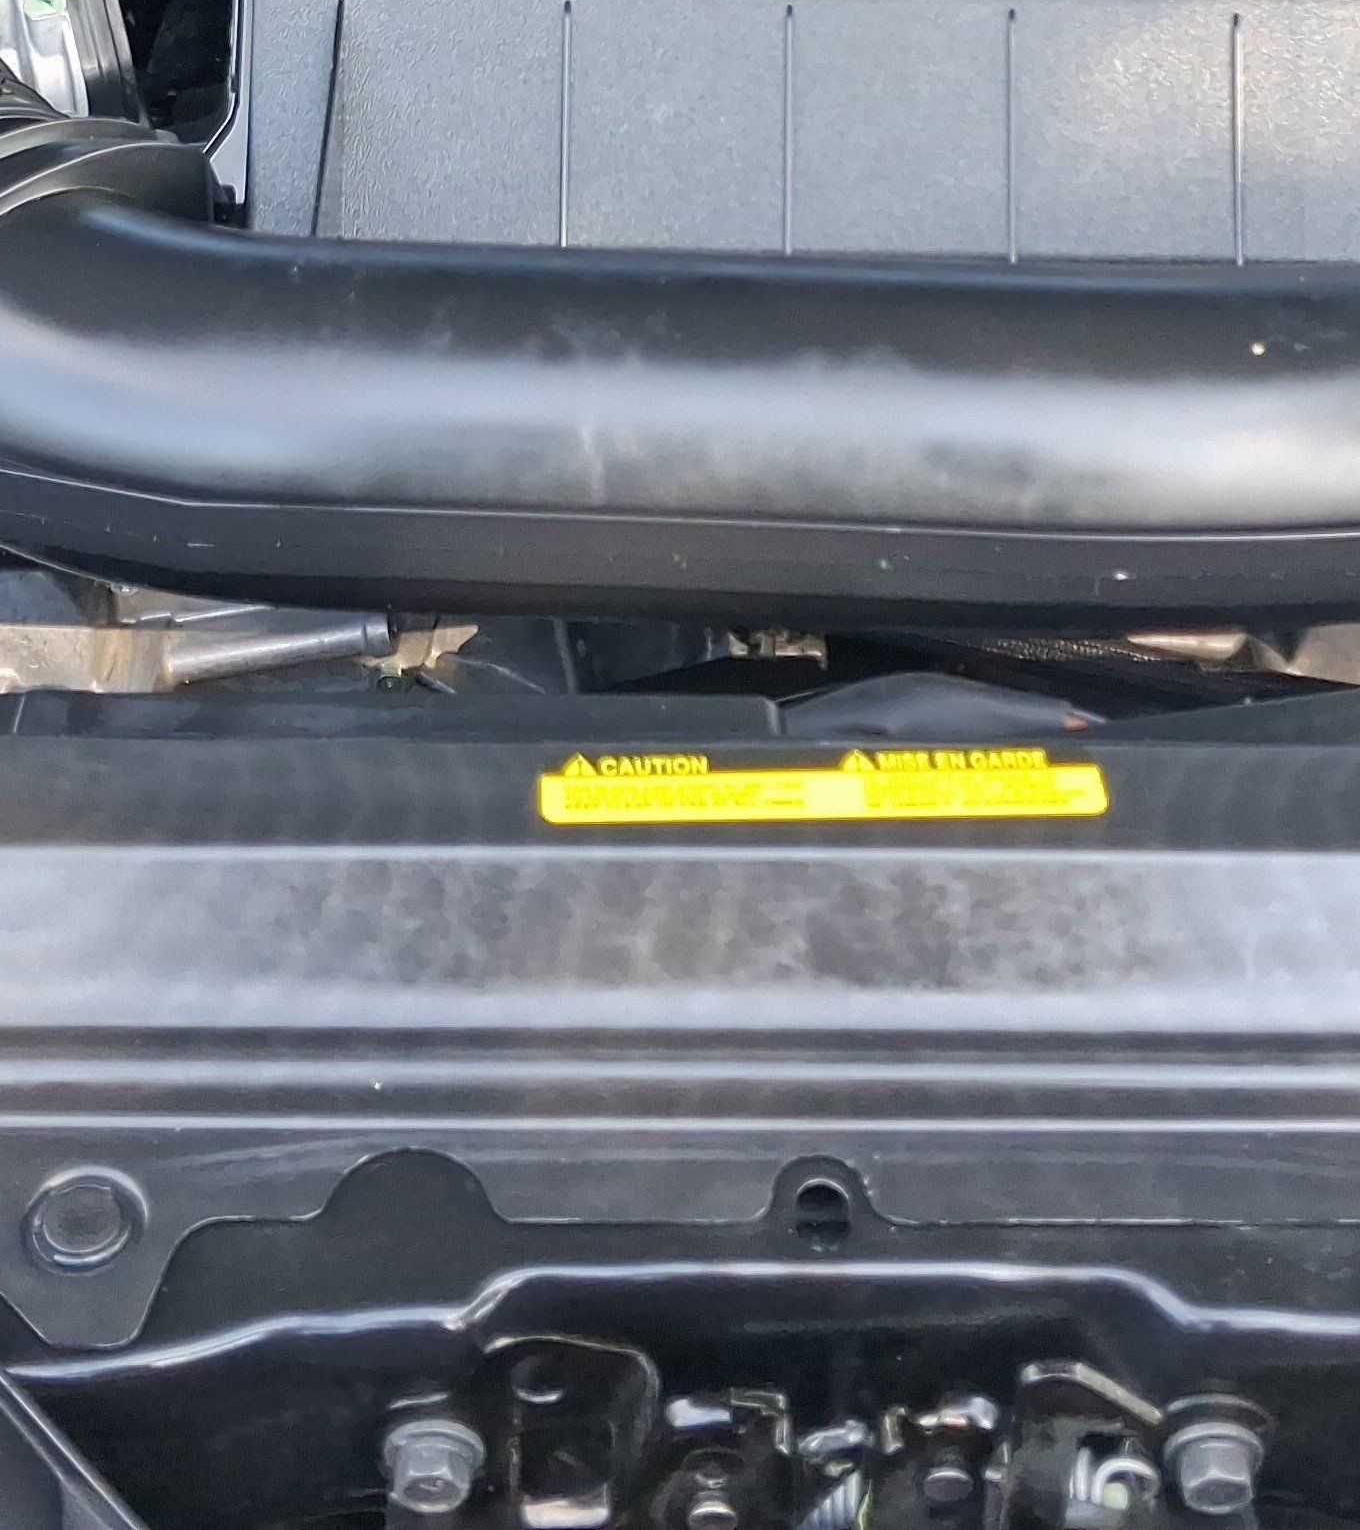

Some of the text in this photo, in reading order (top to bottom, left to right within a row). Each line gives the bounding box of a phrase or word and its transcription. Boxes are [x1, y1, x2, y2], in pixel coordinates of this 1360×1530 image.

[600, 755, 710, 776] CAUTION
[876, 749, 1048, 770] MISE EN GARDE
